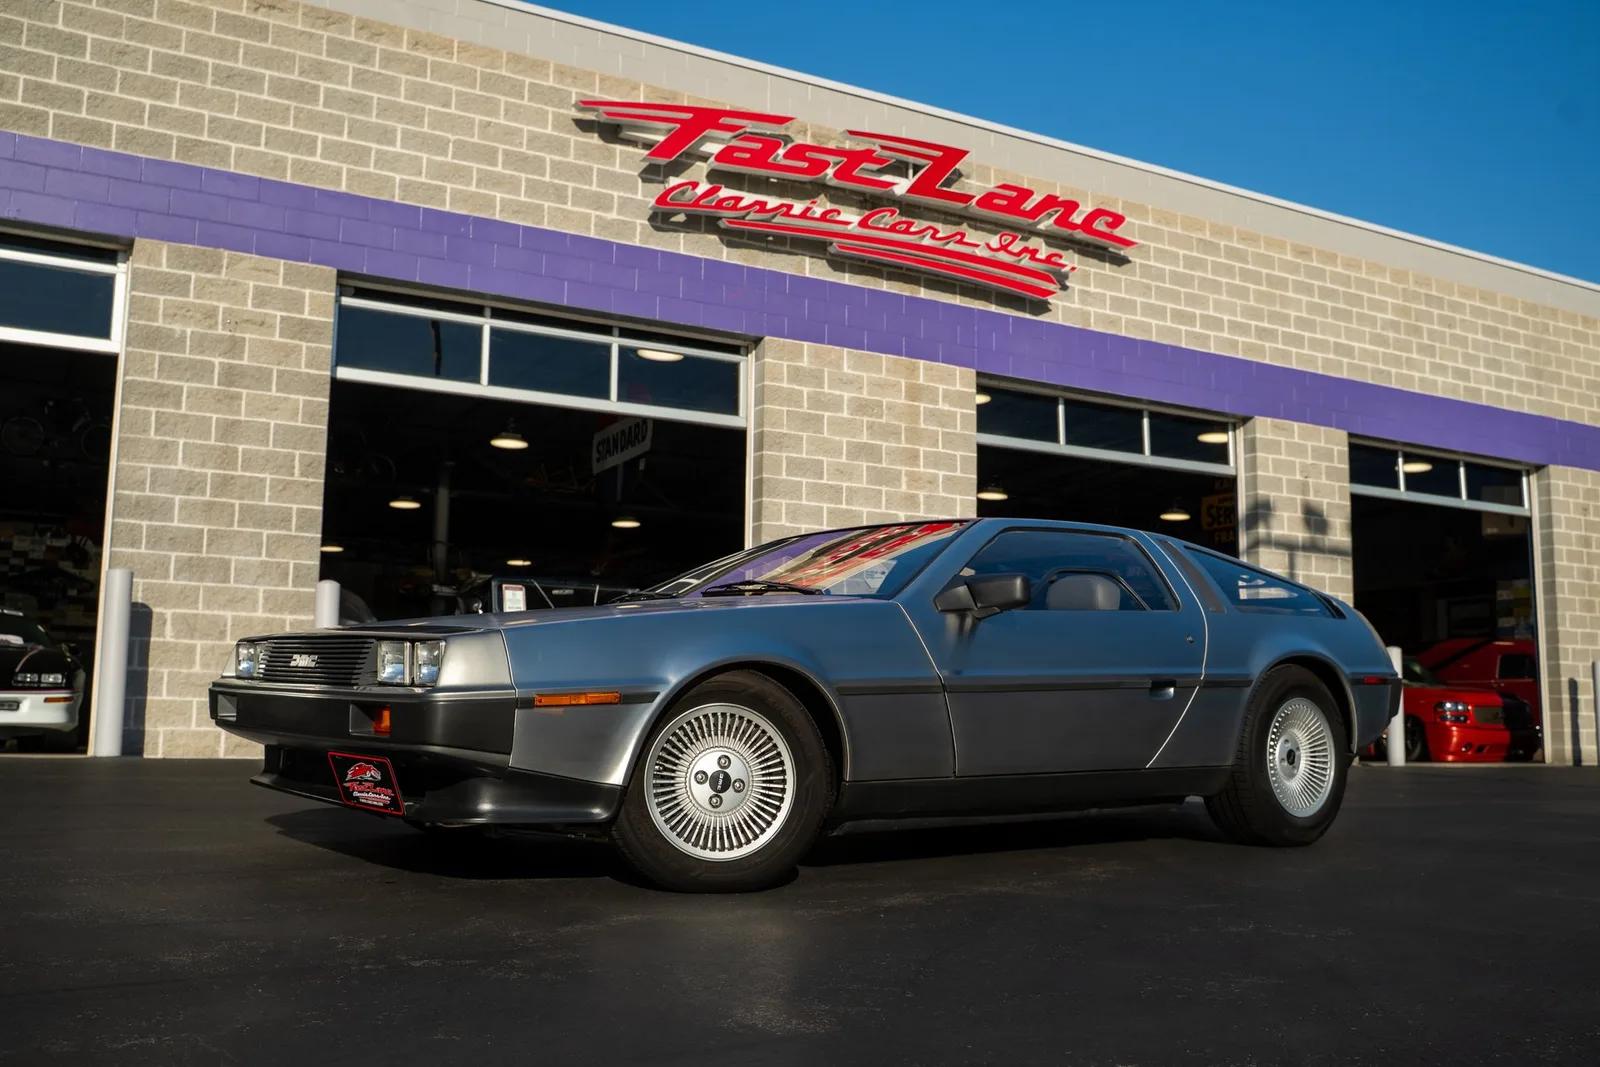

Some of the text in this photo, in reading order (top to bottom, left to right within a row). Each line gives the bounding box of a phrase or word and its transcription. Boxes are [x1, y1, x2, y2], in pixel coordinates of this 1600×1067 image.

[576, 99, 1139, 249] Fast Lane
[654, 180, 854, 227] Classic
[857, 207, 981, 249] Cars
[596, 418, 649, 463] STANDARD
